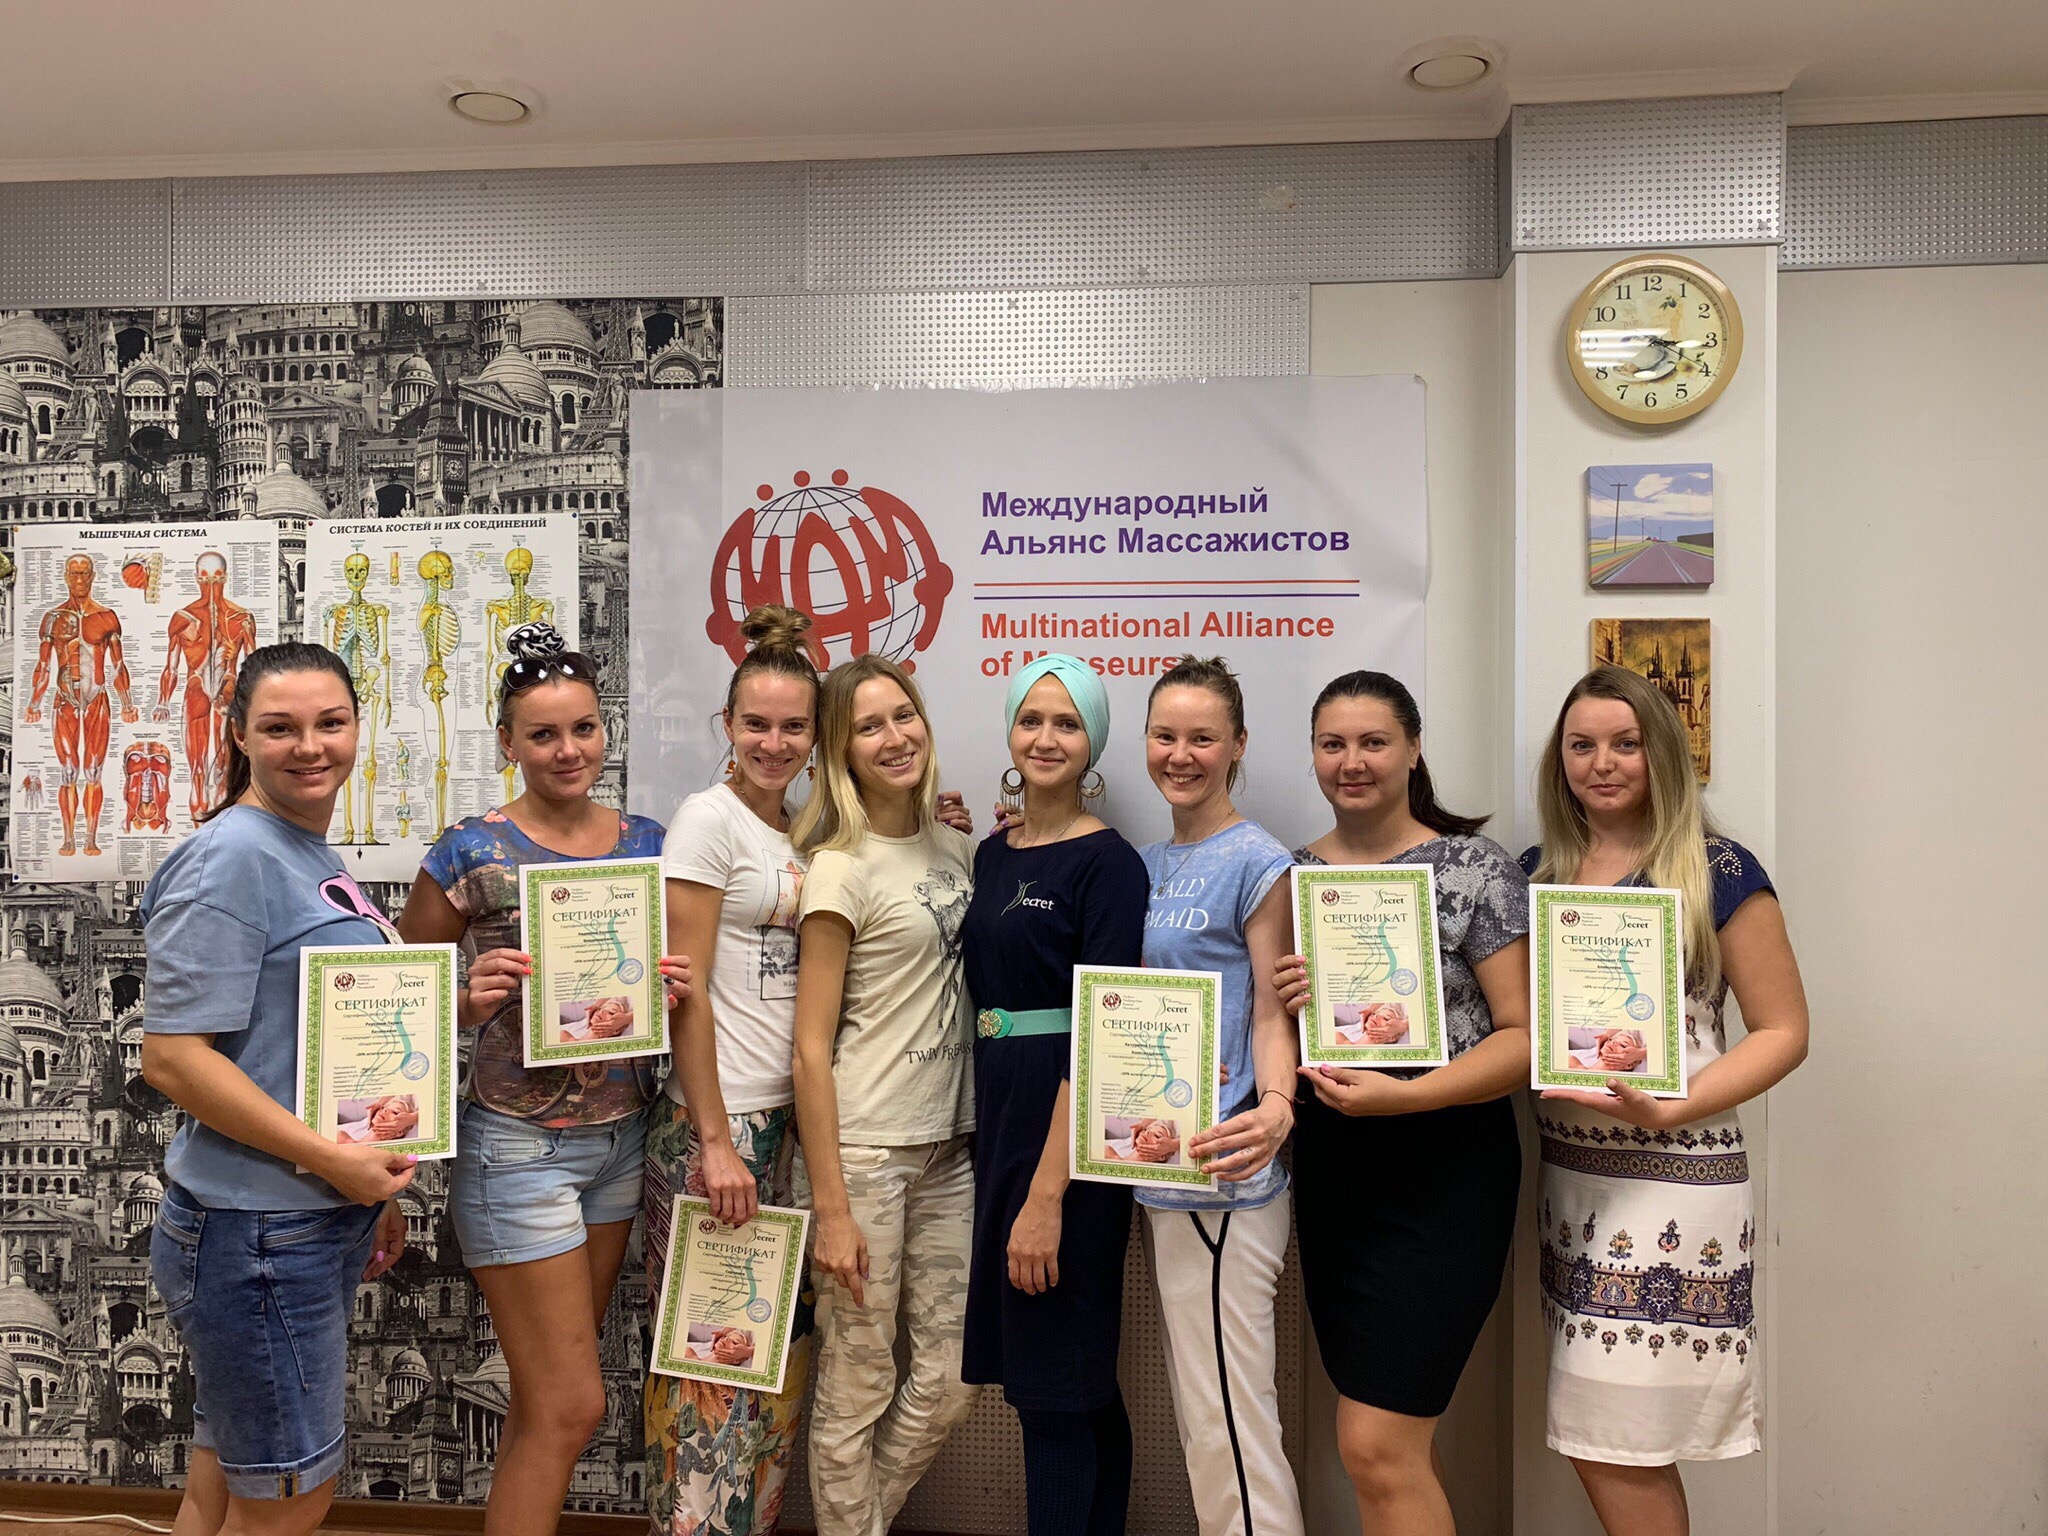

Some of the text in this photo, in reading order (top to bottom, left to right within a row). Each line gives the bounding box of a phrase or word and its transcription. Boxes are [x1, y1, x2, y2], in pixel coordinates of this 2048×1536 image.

[1616, 284, 1632, 300] 11
[1642, 276, 1662, 292] 12
[1679, 283, 1686, 298] 1
[1595, 306, 1616, 322] 10
[1698, 303, 1710, 319] 2
[1706, 332, 1718, 348] 3
[1596, 366, 1608, 380] 8
[1698, 362, 1712, 377] 4
[1616, 385, 1630, 400] 7
[1675, 383, 1688, 399] 5
[1644, 392, 1658, 408] 6
[981, 486, 1268, 522] Международный
[329, 517, 547, 534] СИСТЕМА КОСТЕЙ И ИХ СОЕДИНЕНИЙ
[79, 529, 208, 539] МЫШЕЧНАЯ СИСТЕМА
[980, 528, 1350, 555] Альянс Массажистов
[981, 611, 1335, 638] Multinational Alliance
[980, 651, 1012, 676] of
[552, 907, 638, 922] СЕРТИФИКАТ
[1323, 913, 1408, 924] СЕРТИФИКАТ
[1561, 934, 1652, 948] СЕРТИФИКАТ
[334, 996, 428, 1011] СЕРТИФИКАТ
[1102, 1018, 1191, 1033] СЕРТИФИКАТ
[906, 1047, 939, 1064] TWIN
[697, 1240, 777, 1260] СЕРТИФИКАТ
